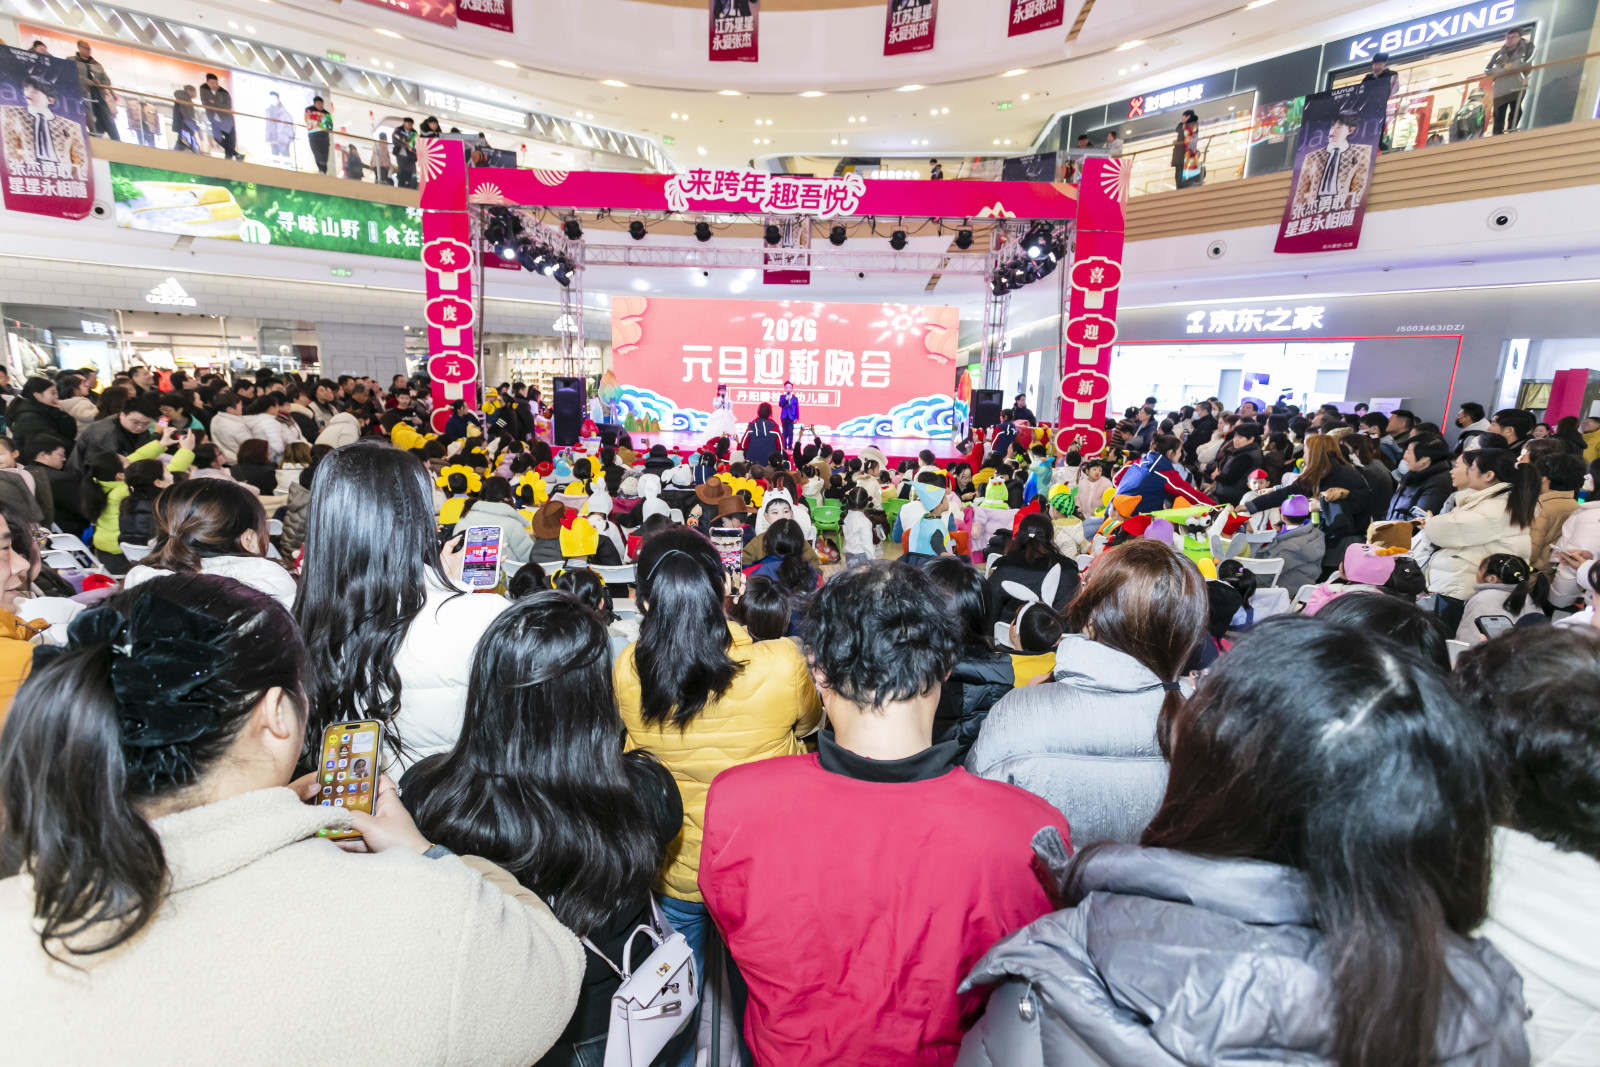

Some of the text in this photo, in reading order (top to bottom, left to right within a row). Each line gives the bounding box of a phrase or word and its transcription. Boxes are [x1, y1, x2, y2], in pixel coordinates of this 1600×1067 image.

[715, 16, 754, 34] 江苏星星
[892, 4, 932, 27] 江苏星星
[712, 32, 752, 51] 永爱张杰
[888, 21, 930, 45] 永爱张杰
[1349, 0, 1515, 61] K-BOXING
[8, 176, 88, 199] 星星永相随
[682, 167, 855, 215] 来跨年 趣吾悦
[1291, 191, 1361, 220] 张杰勇敢飞
[276, 210, 360, 240] 寻味山野
[383, 225, 424, 247] 食在
[1284, 209, 1356, 238] 星星永相随
[762, 318, 817, 342] 2026
[1208, 306, 1325, 333] 京东之家
[682, 345, 891, 388] 元旦迎新晚会
[736, 390, 829, 404] 丹阳碧桂幼儿园
